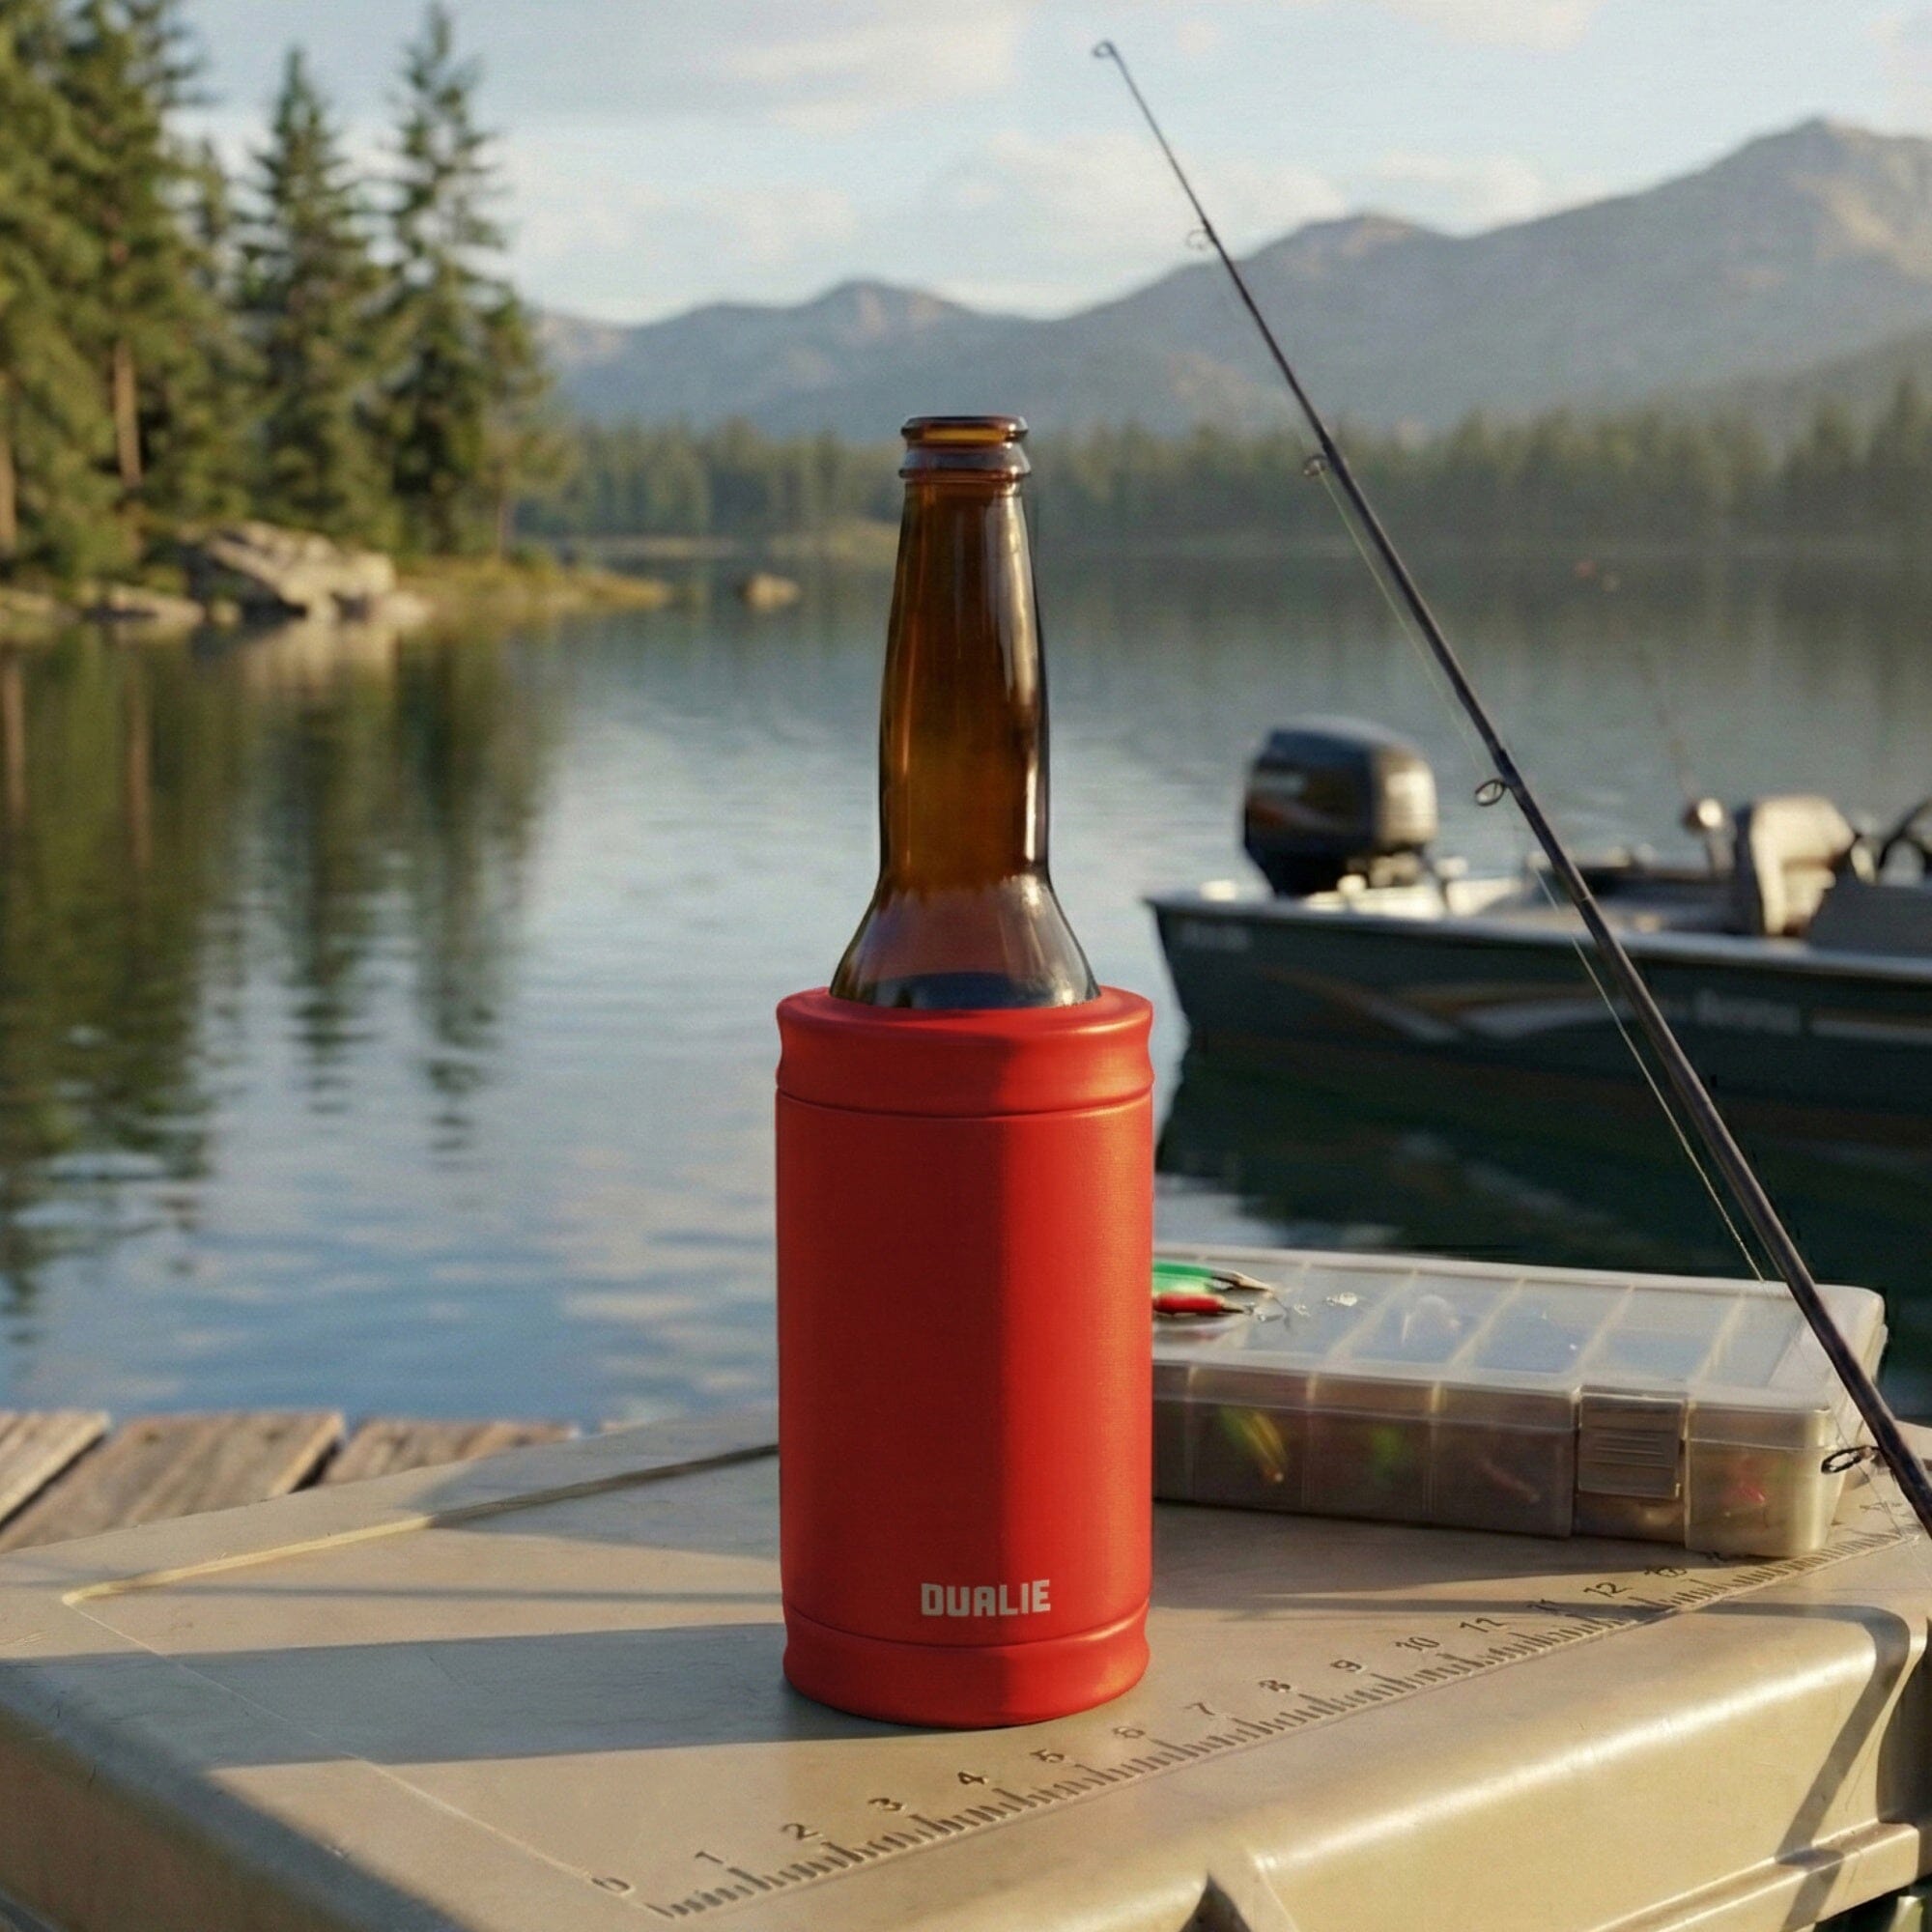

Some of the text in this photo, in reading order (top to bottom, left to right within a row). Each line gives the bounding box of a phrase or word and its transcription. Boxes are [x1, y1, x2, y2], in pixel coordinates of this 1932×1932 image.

[921, 1578, 1052, 1617] DUALIE
[694, 1850, 724, 1865] 1
[780, 1822, 821, 1841] 2
[867, 1797, 904, 1812] 3
[956, 1770, 989, 1787] 4
[1029, 1748, 1065, 1764] 5
[1112, 1726, 1147, 1739] 6
[1183, 1701, 1216, 1716] 7
[1330, 1659, 1363, 1672] 9
[1395, 1635, 1441, 1652] 10
[1582, 1581, 1634, 1599] 12
